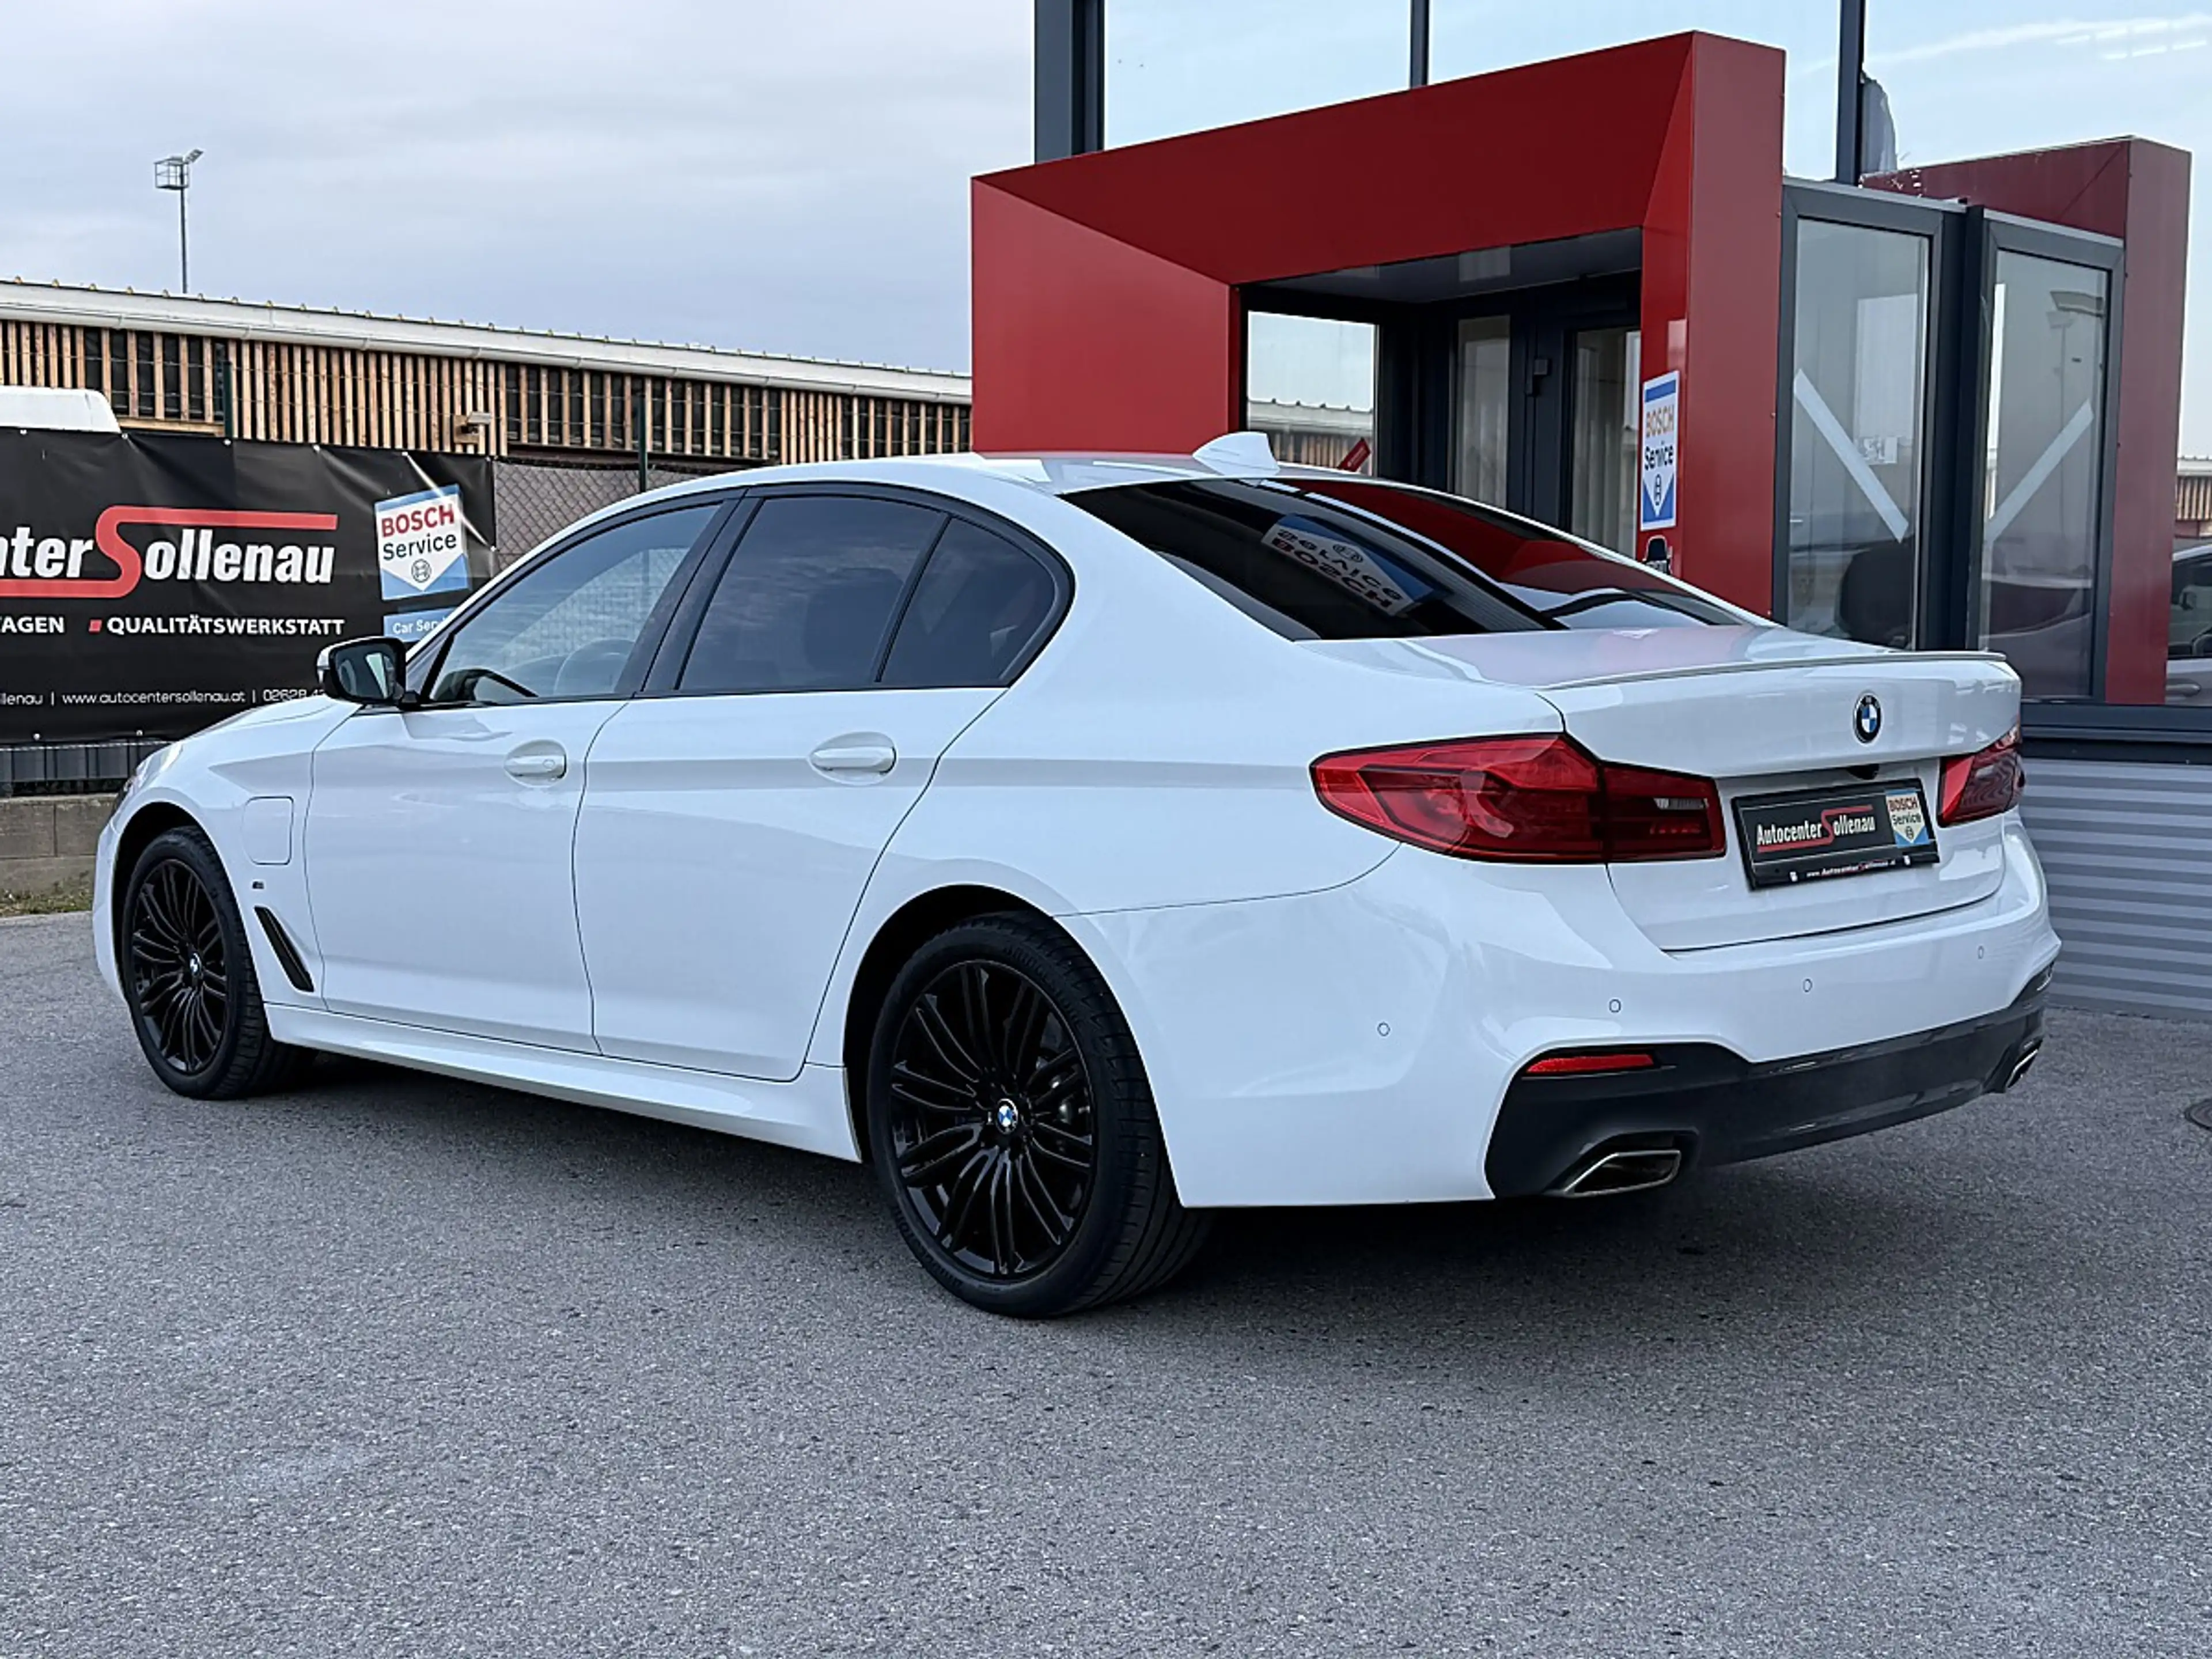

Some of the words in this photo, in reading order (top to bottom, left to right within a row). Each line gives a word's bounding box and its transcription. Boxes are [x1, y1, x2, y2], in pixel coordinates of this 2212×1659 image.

[1646, 405, 1674, 438] BOSCH
[1645, 441, 1673, 471] Service
[381, 504, 455, 537] BOSCH
[383, 533, 457, 560] Service
[0, 616, 65, 633] AGEN
[107, 614, 344, 635] QUALITÄTSWERKSTATT
[393, 622, 414, 634] Car
[62, 690, 246, 704] www.autocentersollenau.at
